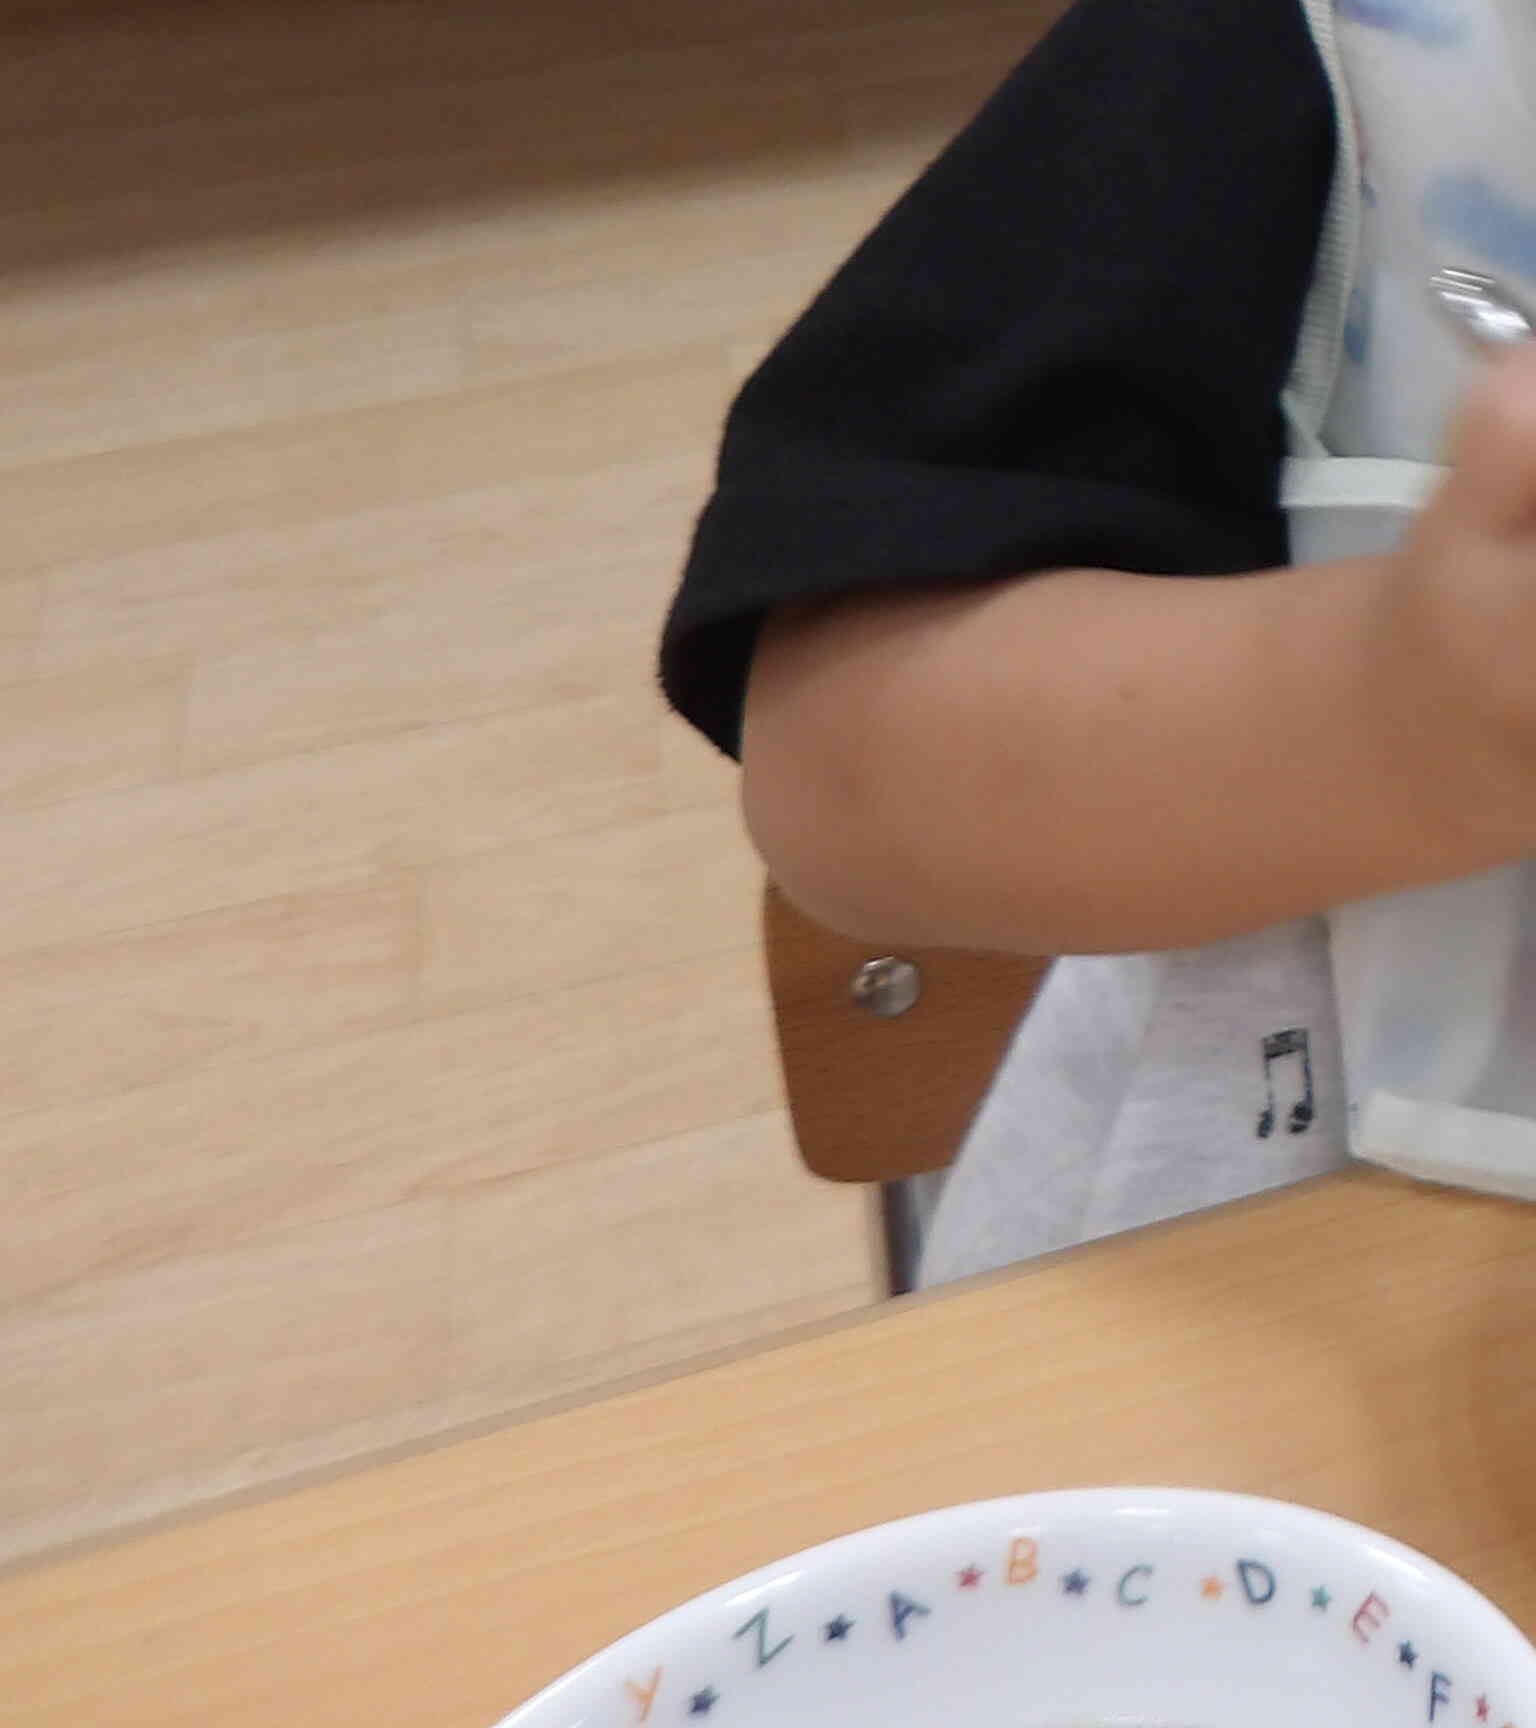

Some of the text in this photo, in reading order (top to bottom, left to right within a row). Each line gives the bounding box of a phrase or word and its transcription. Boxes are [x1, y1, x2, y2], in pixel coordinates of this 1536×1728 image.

[623, 1535, 1454, 1723] Y Z A B C D E F
